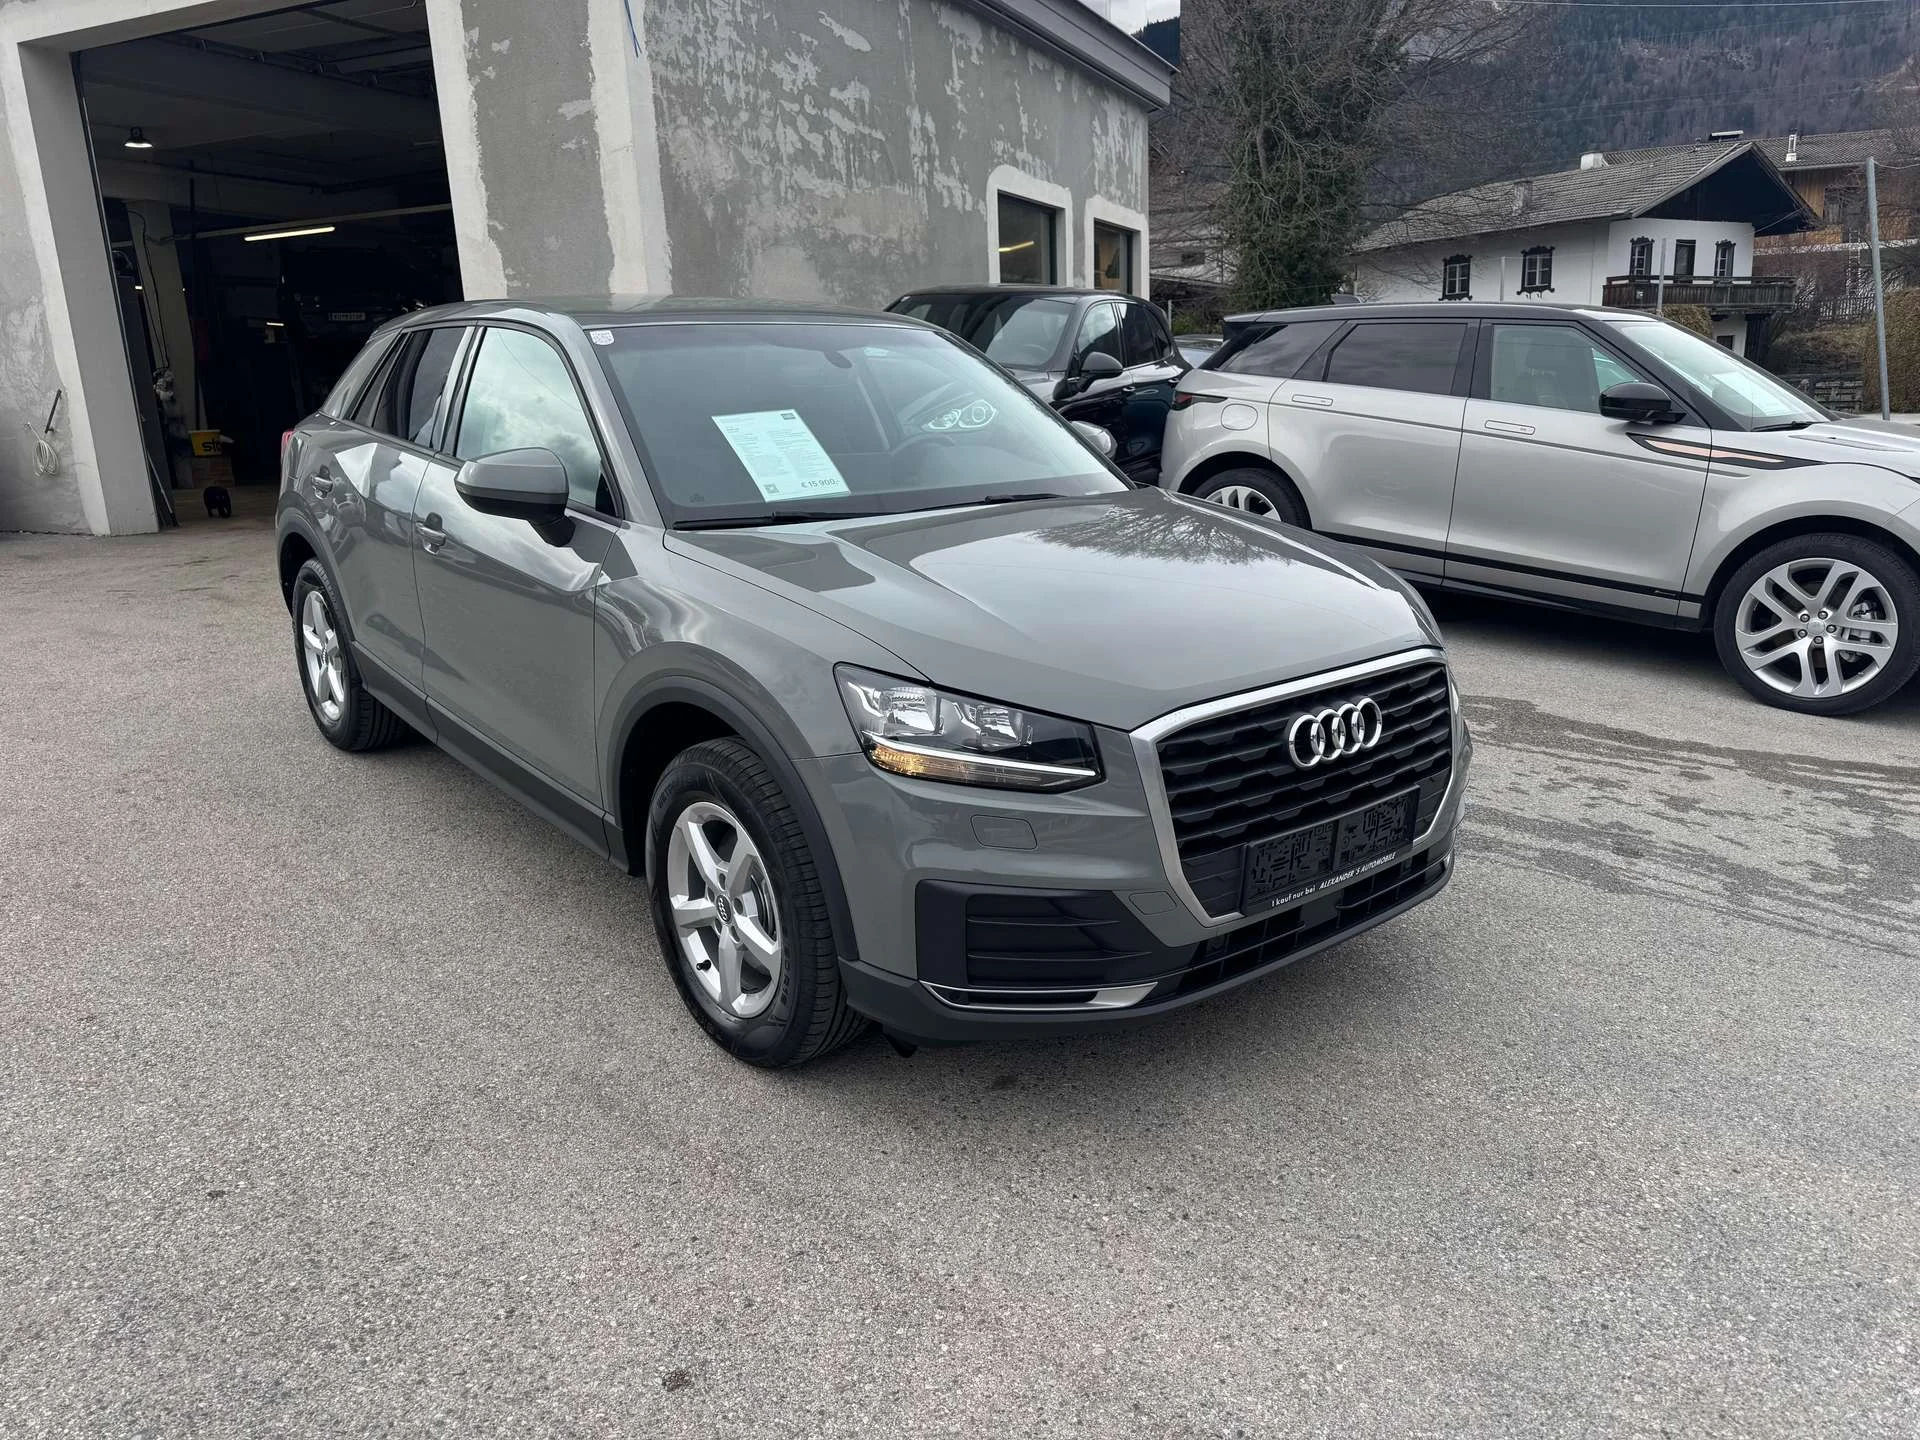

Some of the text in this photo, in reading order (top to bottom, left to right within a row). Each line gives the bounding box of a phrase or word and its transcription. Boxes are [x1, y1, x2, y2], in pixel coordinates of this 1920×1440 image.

[1275, 895, 1292, 906] kauf
[1292, 891, 1304, 900] nur
[1305, 884, 1316, 895] bei
[1360, 852, 1396, 873] AUTOMOBILE
